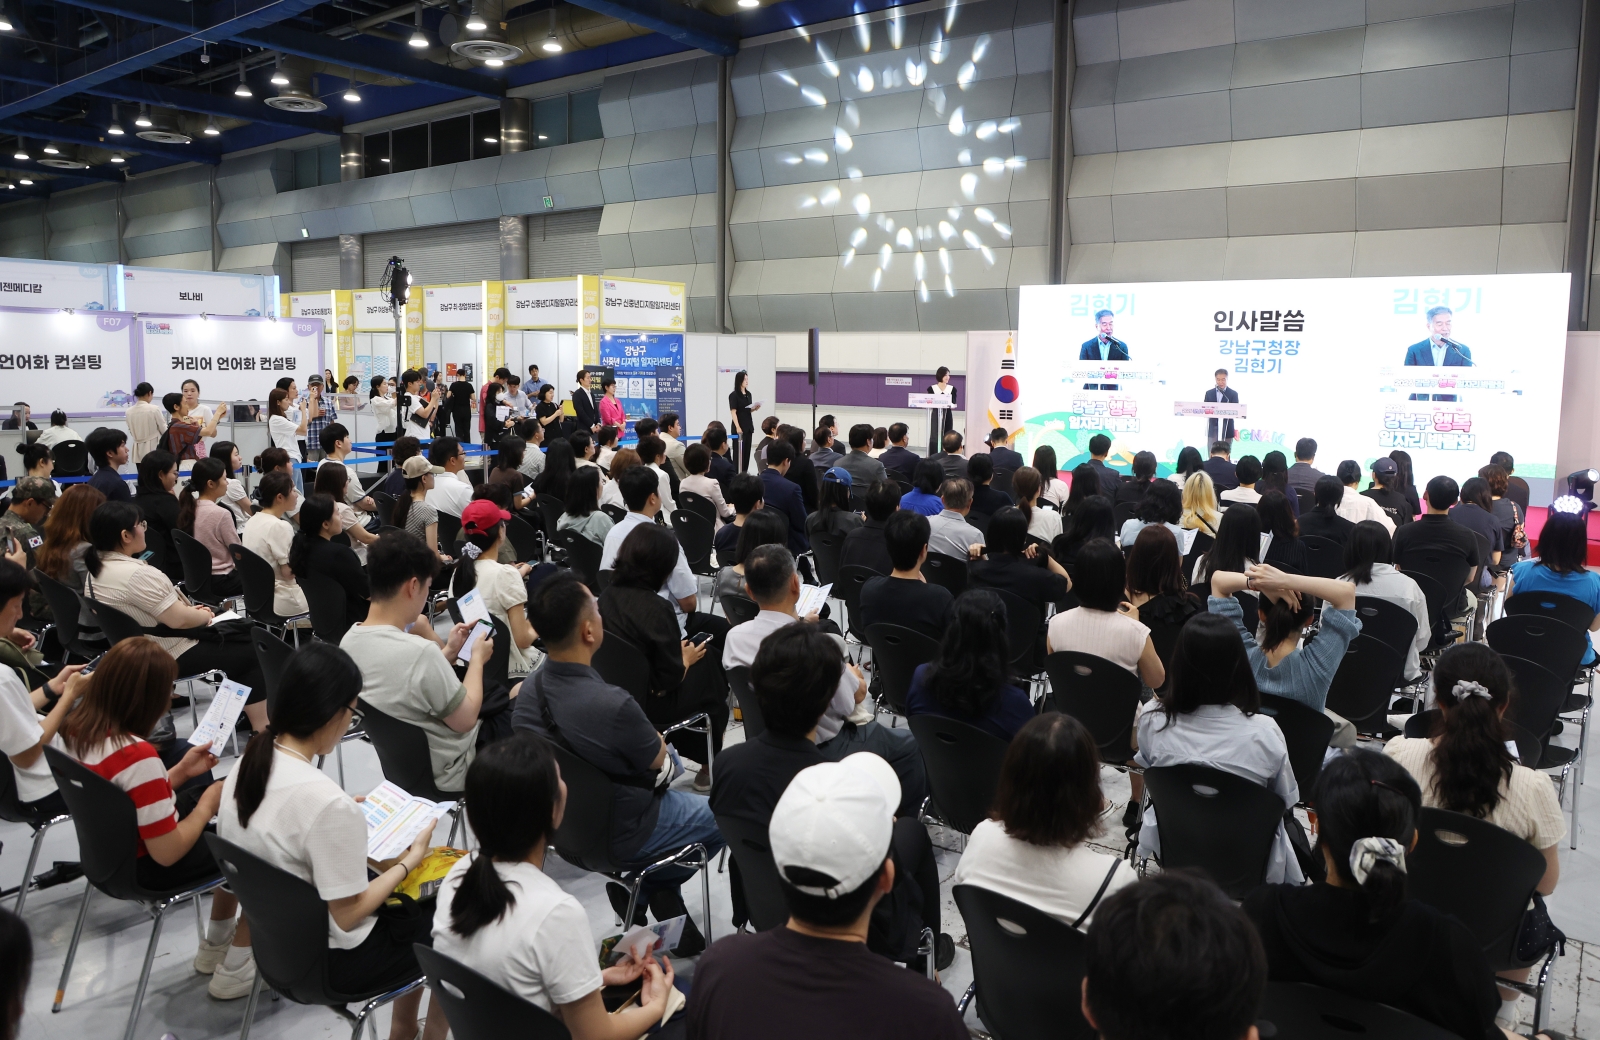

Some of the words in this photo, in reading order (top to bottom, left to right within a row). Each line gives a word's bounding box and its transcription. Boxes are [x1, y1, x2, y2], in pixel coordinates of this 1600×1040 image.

[0, 282, 42, 293] 젠메디칼
[179, 291, 203, 301] 보나비
[605, 298, 622, 307] 강남구
[1393, 287, 1482, 315] 김현기
[516, 300, 530, 309] 강남구
[1069, 293, 1136, 316] 김현기
[1214, 310, 1305, 332] 인사말씀
[624, 346, 647, 356] 강남구
[1220, 340, 1301, 356] 강남구청장
[0, 354, 49, 370] 언어화
[55, 354, 102, 370] 컨설팅
[171, 357, 212, 370] 커리어
[217, 357, 256, 370] 언어화
[259, 357, 296, 370] 컨설팅
[602, 356, 619, 367] 신중년
[621, 357, 640, 367] 디지털
[641, 357, 673, 367] 일자리센터
[1235, 358, 1282, 374] 김현기
[1415, 379, 1438, 387] 강남구
[1438, 379, 1456, 388] 행복
[1072, 400, 1108, 415] 강남구
[1109, 400, 1137, 417] 행복
[1068, 416, 1104, 431] 일자리
[1384, 412, 1432, 430] 강남구
[1433, 412, 1472, 433] 행복
[1378, 430, 1426, 449] 일자리
[1426, 432, 1476, 451] 박람회
